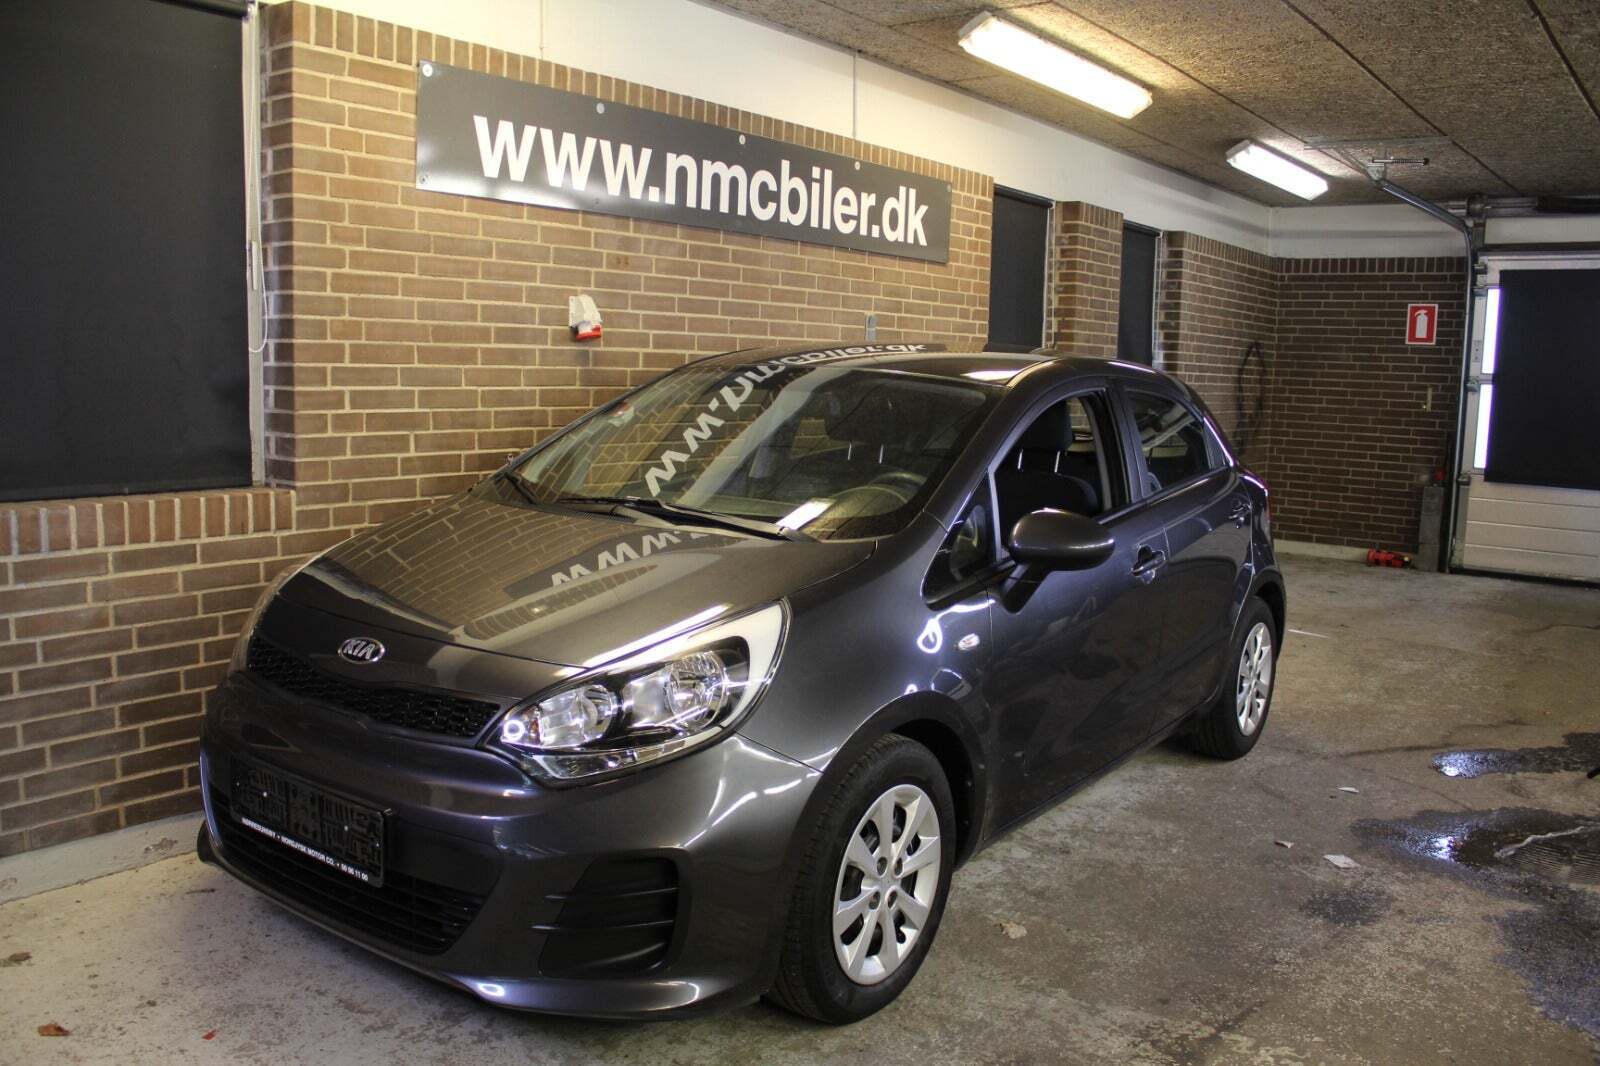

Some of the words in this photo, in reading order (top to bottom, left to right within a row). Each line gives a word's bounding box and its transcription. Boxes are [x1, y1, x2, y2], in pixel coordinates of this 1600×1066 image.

[473, 114, 928, 247] www.nmcbiler.dk
[342, 640, 376, 660] KIA
[307, 847, 326, 862] MOTOR
